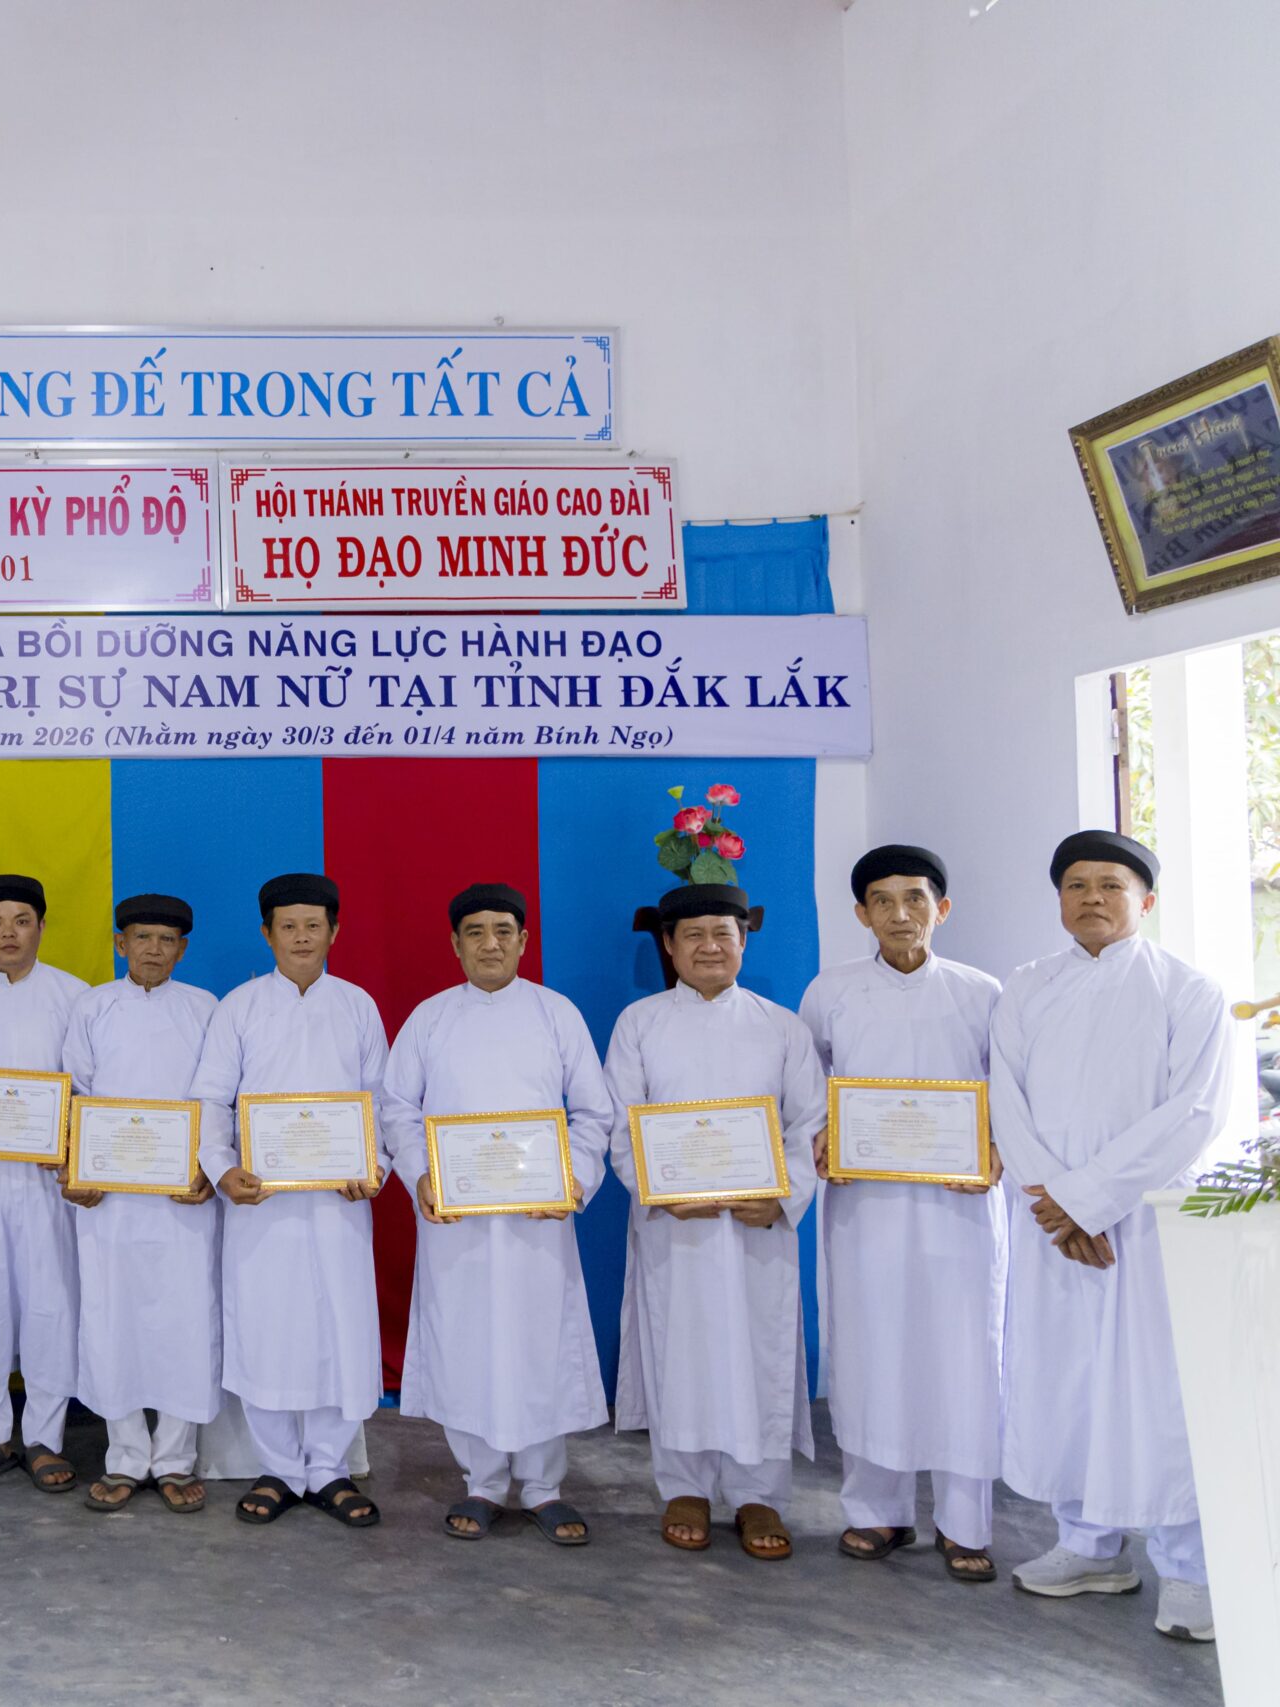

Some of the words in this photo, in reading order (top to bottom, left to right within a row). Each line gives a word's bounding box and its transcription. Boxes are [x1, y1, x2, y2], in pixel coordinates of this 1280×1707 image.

[90, 347, 168, 417] ĐẾ
[180, 371, 377, 418] TRONG
[392, 347, 501, 417] TẤT
[517, 355, 591, 418] CẢ
[9, 485, 52, 537] KỲ
[65, 474, 131, 537] PHỔ
[142, 485, 187, 544] ĐỘ
[255, 481, 296, 523] HỘI
[304, 480, 384, 518] THÁNH
[392, 475, 486, 517] TRUYỀN
[494, 480, 548, 517] GIÁO
[556, 487, 602, 517] CAO
[610, 480, 650, 516] ĐÀI
[262, 535, 321, 590] HỌ
[336, 534, 422, 589] ĐẠO
[437, 535, 549, 578] MINH
[562, 523, 650, 578] ĐỨC
[18, 618, 83, 659] BỒI
[96, 623, 235, 659] DƯỠNG
[247, 622, 358, 658] NĂNG
[371, 627, 448, 664] LỰC
[461, 622, 568, 658] HÀNH
[580, 629, 663, 664] ĐẠO
[58, 666, 129, 718] SỰ
[143, 674, 261, 709] NAM
[276, 665, 354, 709] NỮ
[368, 674, 458, 717] TẠI
[473, 661, 602, 709] TỈNH
[618, 656, 731, 709] ĐẮK
[744, 656, 852, 709] LẮK
[32, 726, 96, 747] 2026
[104, 722, 198, 750] (Nhằm
[206, 725, 273, 751] ngày
[281, 726, 336, 747] 30/3
[344, 722, 394, 746] đến
[403, 725, 457, 746] 01/4
[464, 727, 526, 746] năm
[534, 724, 600, 746] Bính
[609, 725, 675, 751] Ngọ)
